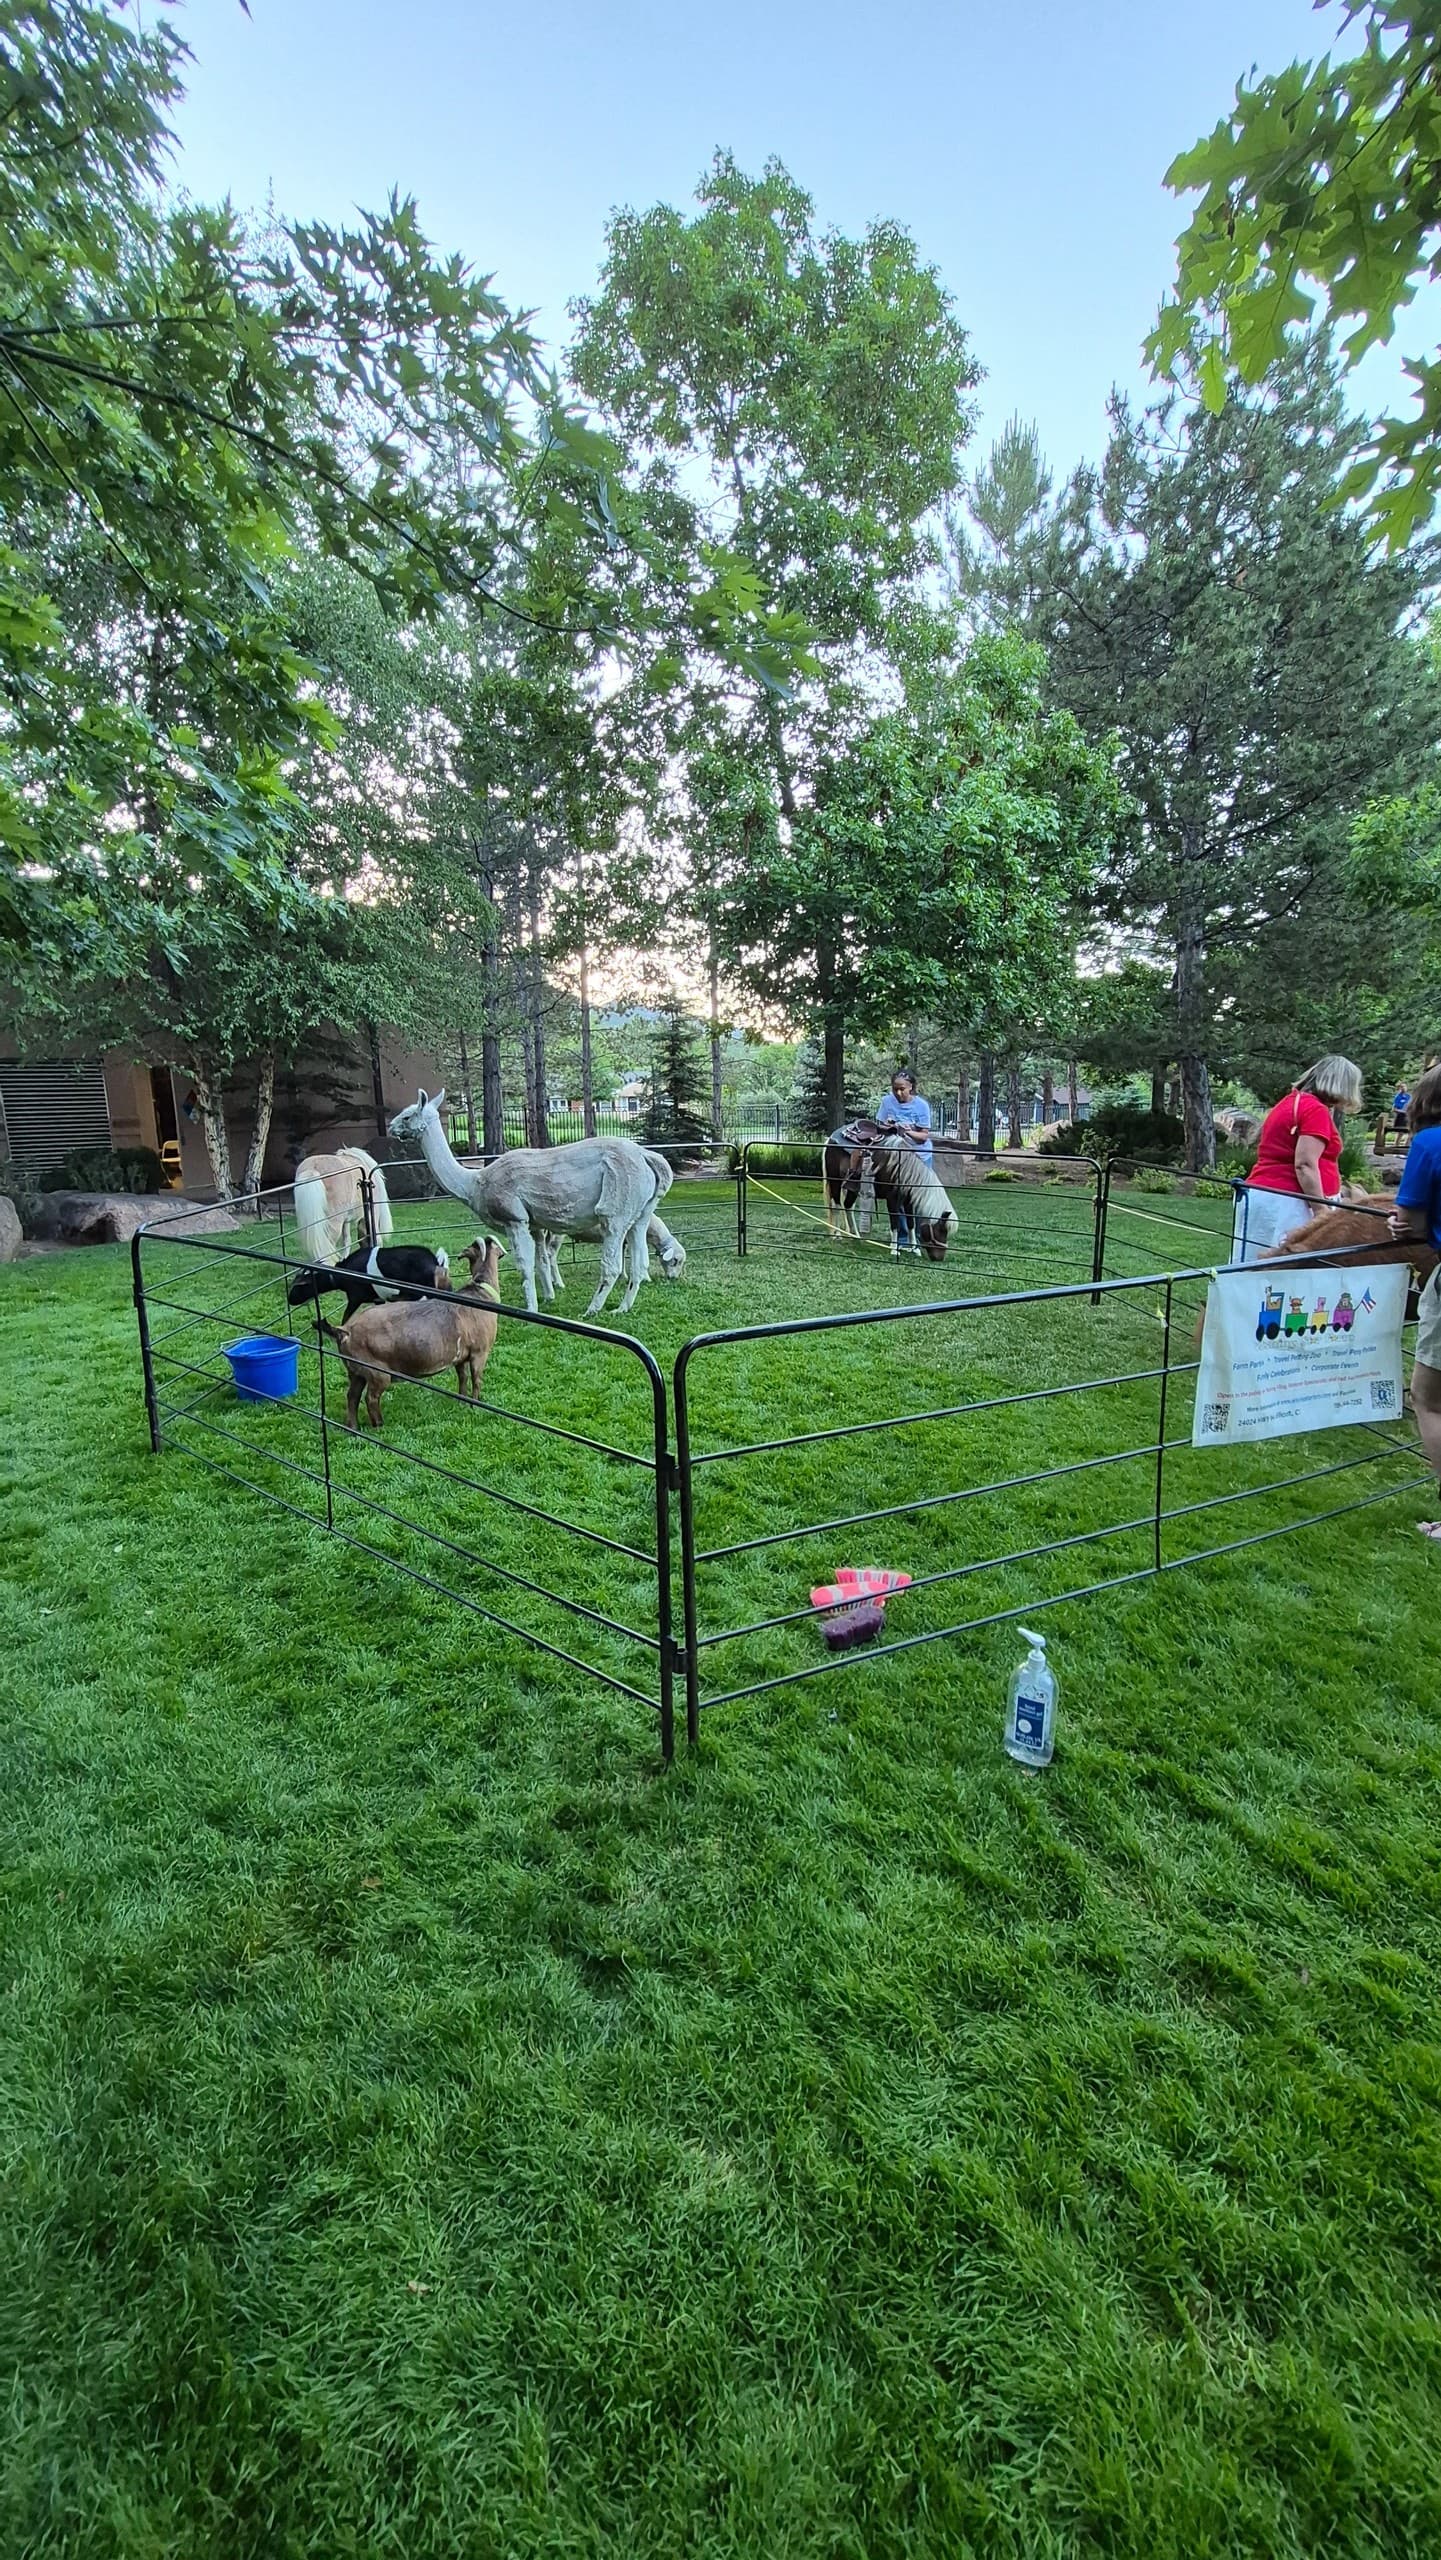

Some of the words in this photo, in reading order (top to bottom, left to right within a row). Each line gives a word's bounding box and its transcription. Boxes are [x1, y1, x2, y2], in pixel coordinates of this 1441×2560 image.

[1232, 1362, 1249, 1371] Farm
[1273, 1355, 1290, 1363] Travel
[1311, 1364, 1340, 1372] Corporate
